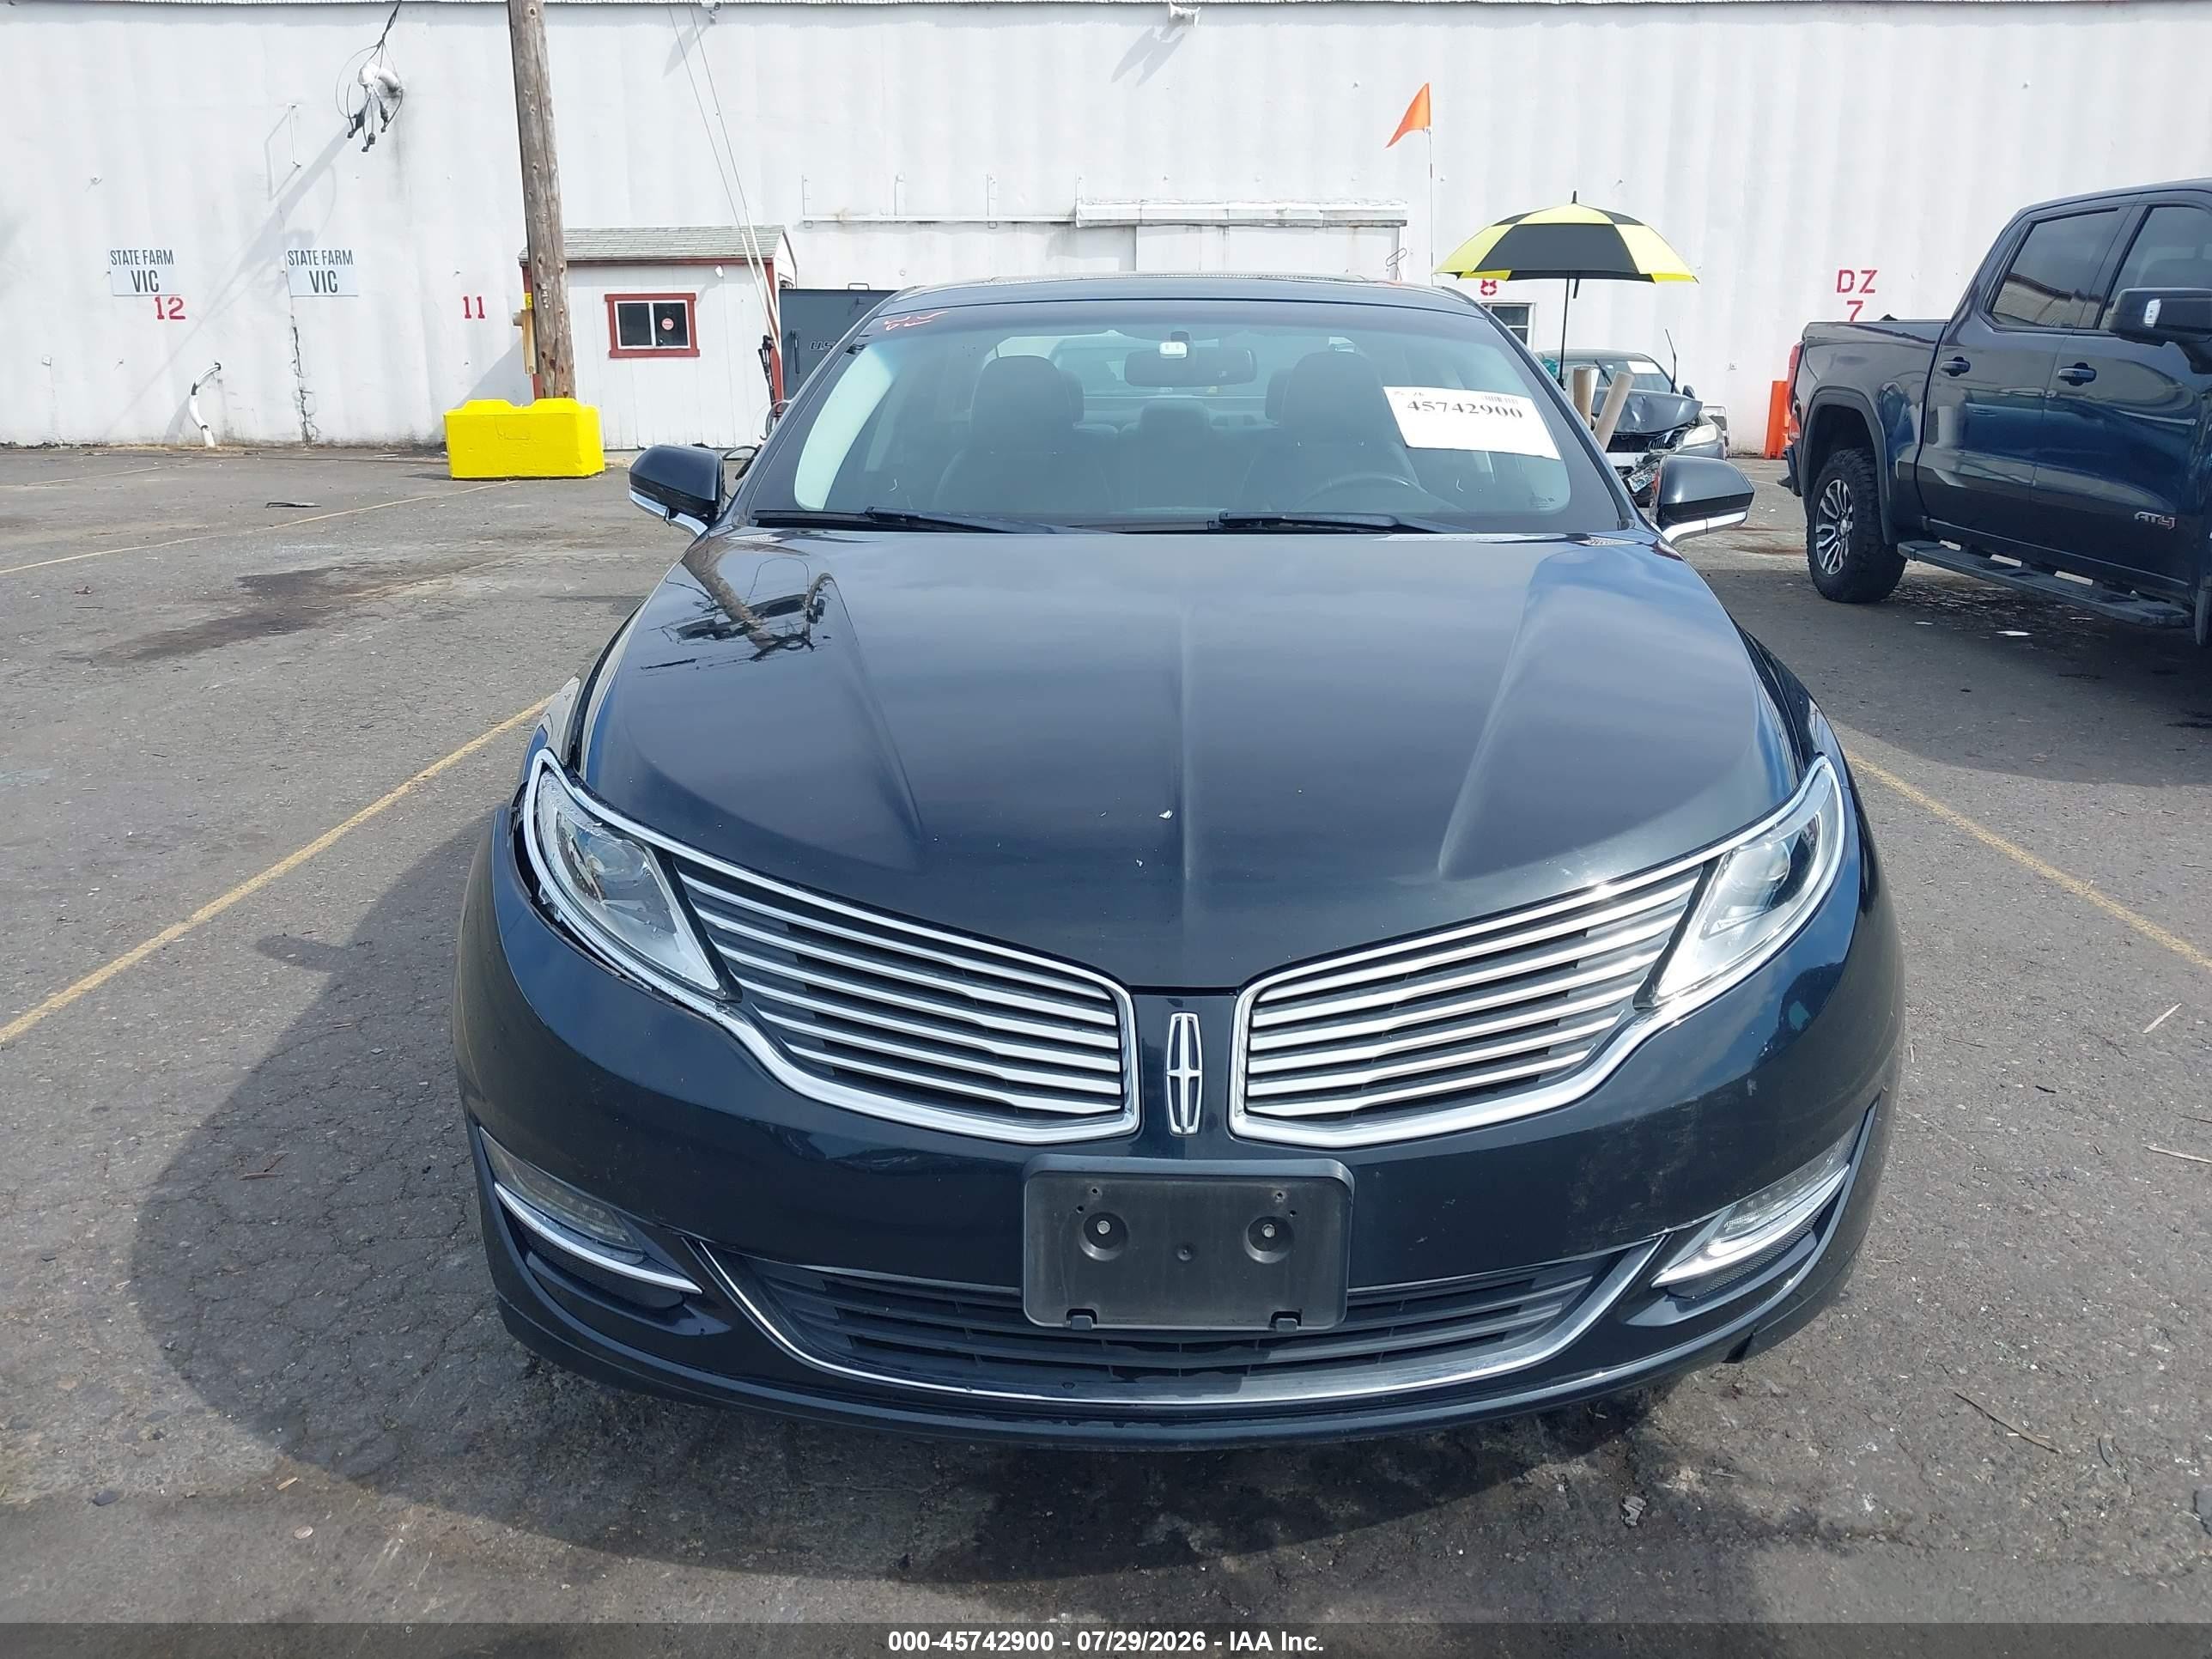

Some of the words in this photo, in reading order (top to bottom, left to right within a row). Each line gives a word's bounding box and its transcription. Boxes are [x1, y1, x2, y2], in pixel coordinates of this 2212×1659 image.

[109, 249, 141, 265] STATE
[143, 249, 174, 265] FARM
[288, 249, 319, 266] STATE
[321, 249, 354, 266] FARM
[130, 269, 160, 293] VIC
[308, 270, 338, 294] VIC
[1480, 277, 1498, 296] 8
[1836, 269, 1878, 293] DZ
[155, 296, 186, 320] 12
[462, 295, 486, 319] 11
[1846, 300, 1863, 323] 7
[1407, 400, 1523, 419] 45742900
[2134, 511, 2177, 530] AT4
